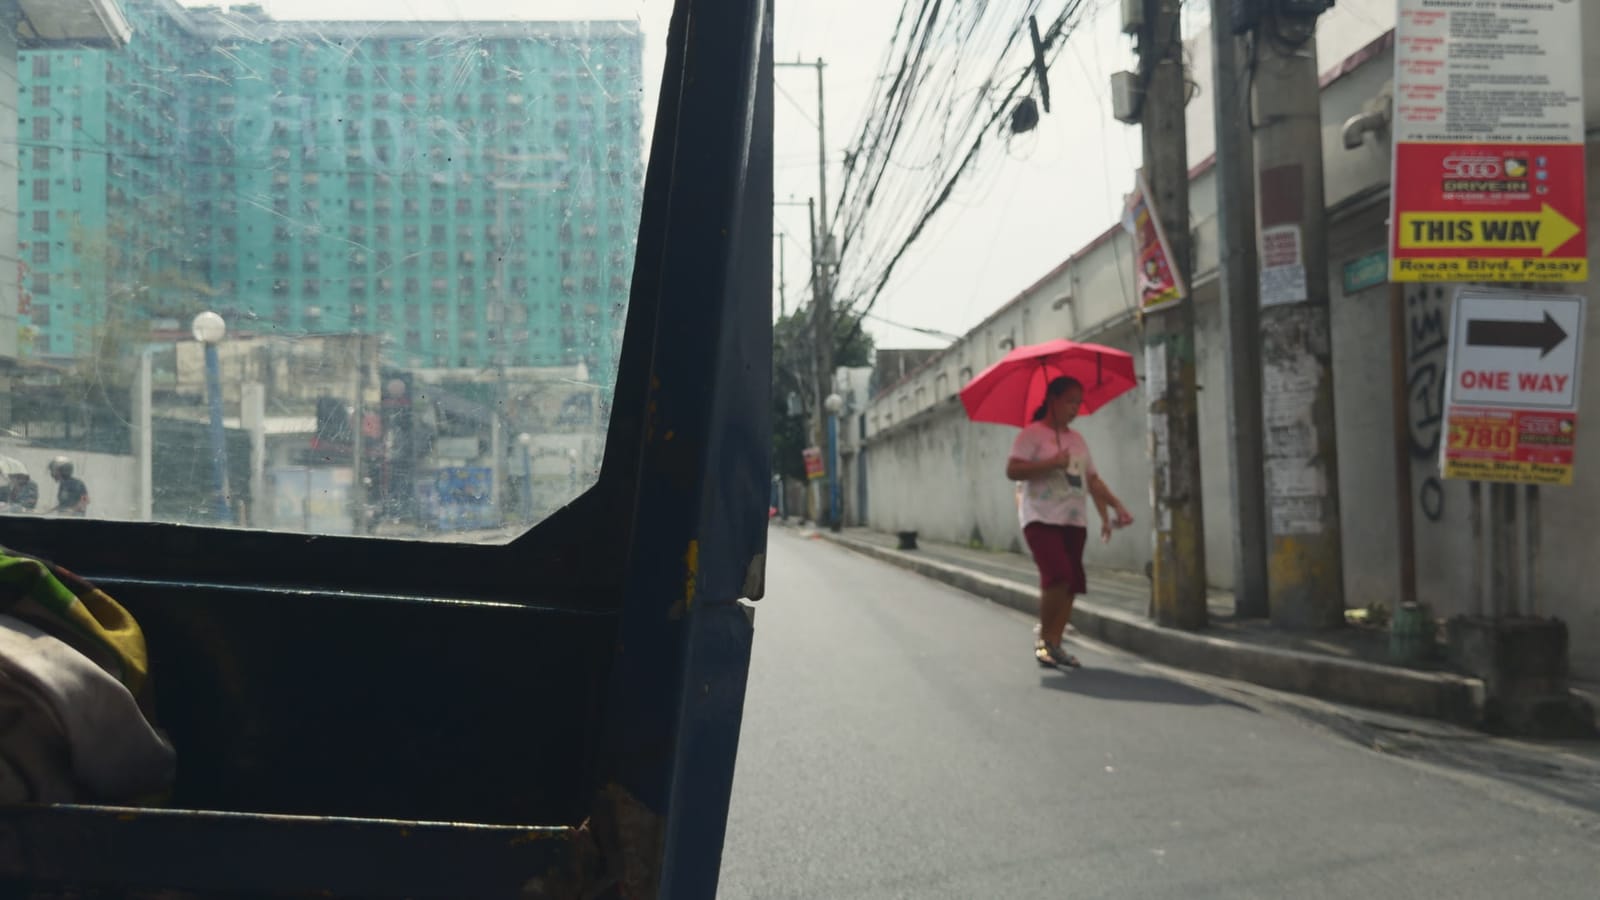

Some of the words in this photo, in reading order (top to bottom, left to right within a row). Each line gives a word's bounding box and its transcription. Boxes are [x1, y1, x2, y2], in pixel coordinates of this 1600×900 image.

[1443, 181, 1528, 192] DRIVE-IN
[1410, 221, 1474, 242] THIS
[1480, 221, 1540, 242] WAY
[1400, 260, 1460, 271] Roxas
[1522, 260, 1582, 273] Pasay
[1460, 370, 1510, 391] ONE
[1518, 372, 1569, 393] WAY
